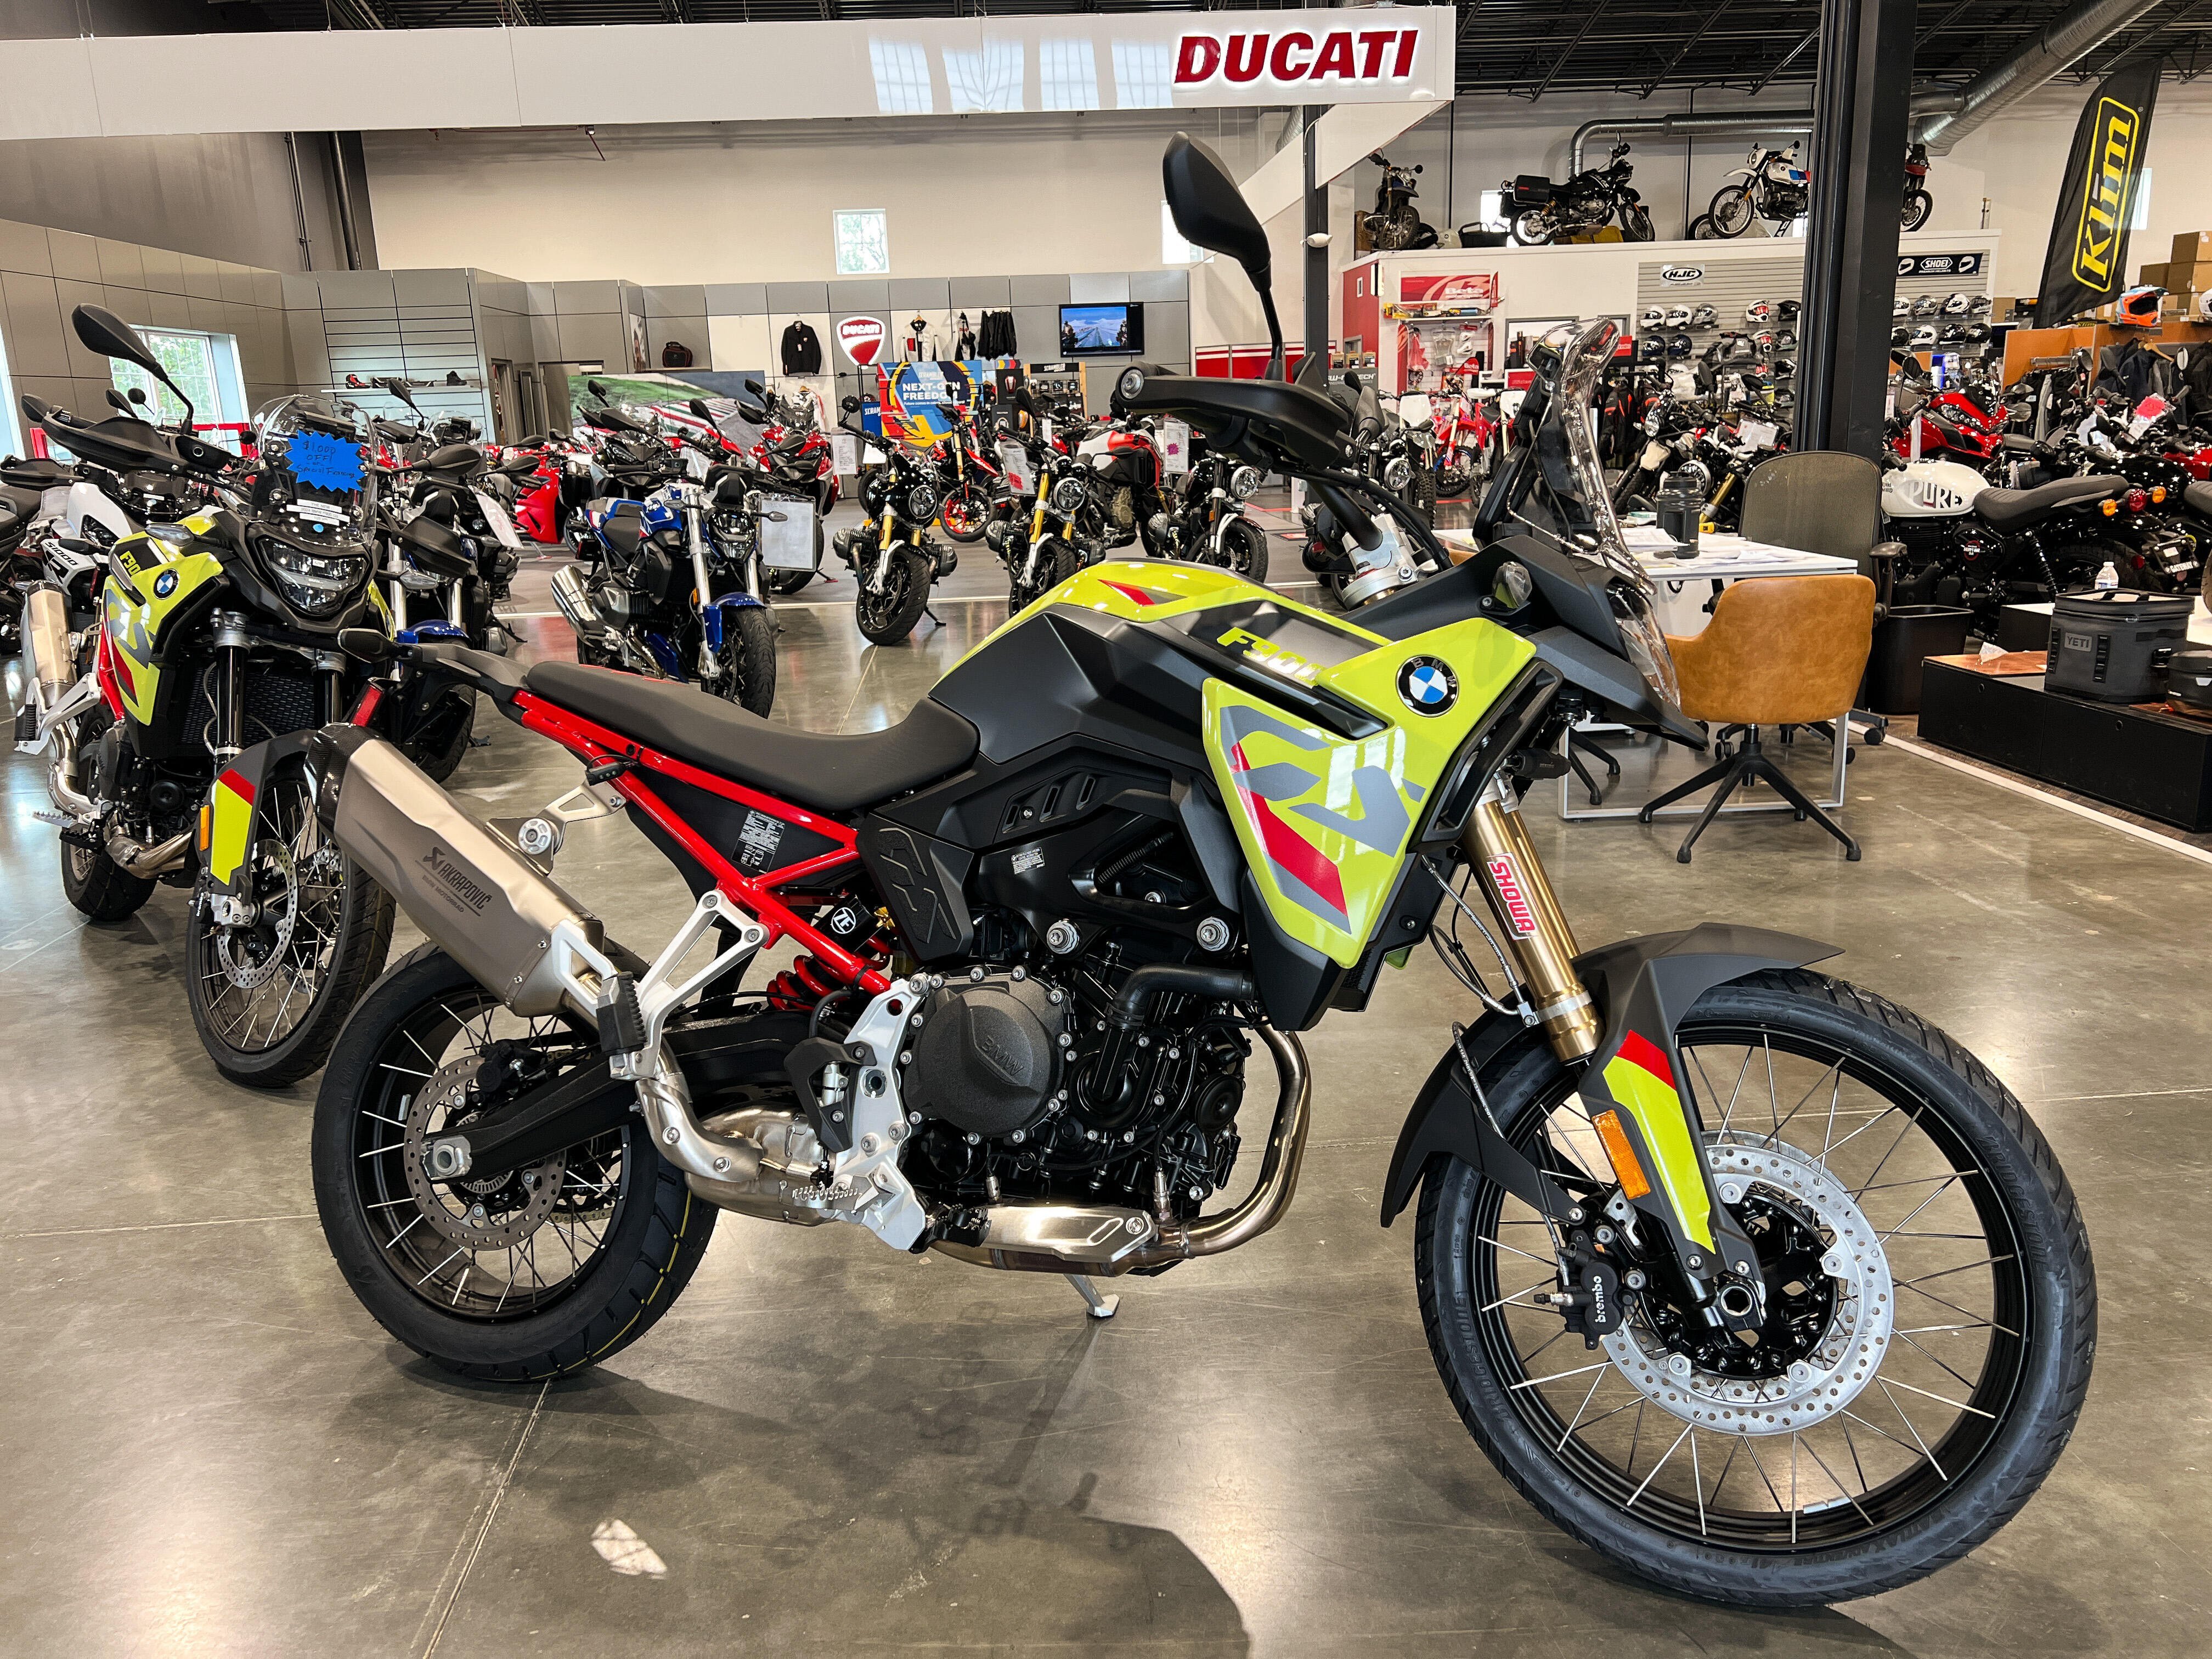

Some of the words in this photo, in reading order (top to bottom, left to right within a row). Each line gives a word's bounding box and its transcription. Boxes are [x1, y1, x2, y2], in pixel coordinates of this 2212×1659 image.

[1174, 30, 1419, 83] DUCATI
[1668, 270, 1696, 279] HJC
[1925, 259, 1948, 268] SHOEI
[842, 324, 880, 335] DUCATI
[902, 381, 961, 392] NEXT-GN
[1909, 481, 1962, 509] PURE
[45, 541, 78, 566] S1000
[2066, 635, 2090, 648] YETI
[422, 874, 436, 888] BMW
[436, 886, 465, 913] MOTORRAD
[1488, 861, 1536, 932] SHOWA
[980, 1034, 1025, 1076] BMW
[1592, 1275, 1606, 1323] brembo
[1454, 1296, 1511, 1421] BRIDGESTONE
